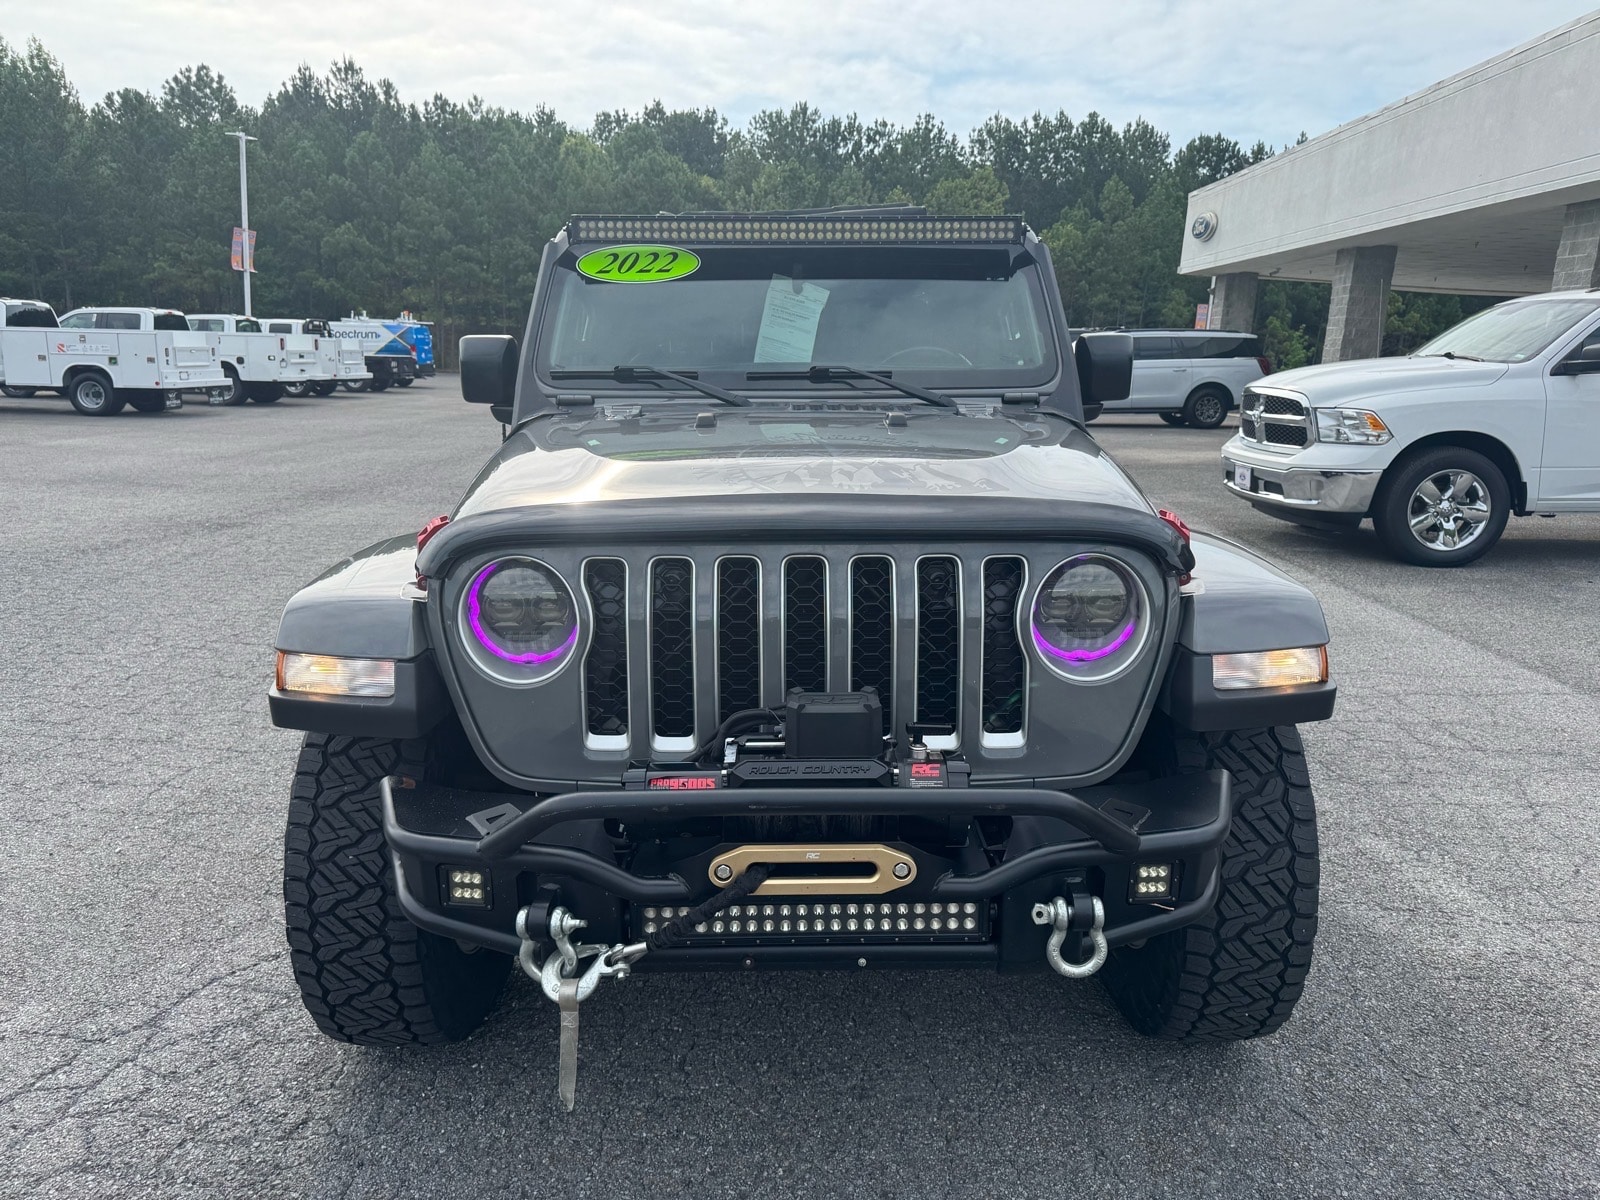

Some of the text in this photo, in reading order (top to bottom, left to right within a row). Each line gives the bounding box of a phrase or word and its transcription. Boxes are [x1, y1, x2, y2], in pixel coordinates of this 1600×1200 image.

[594, 251, 679, 274] 2022
[330, 329, 378, 339] Spectrum
[749, 765, 871, 775] ROUGH COUNTRY
[911, 763, 941, 774] RC
[806, 852, 820, 860] RC
